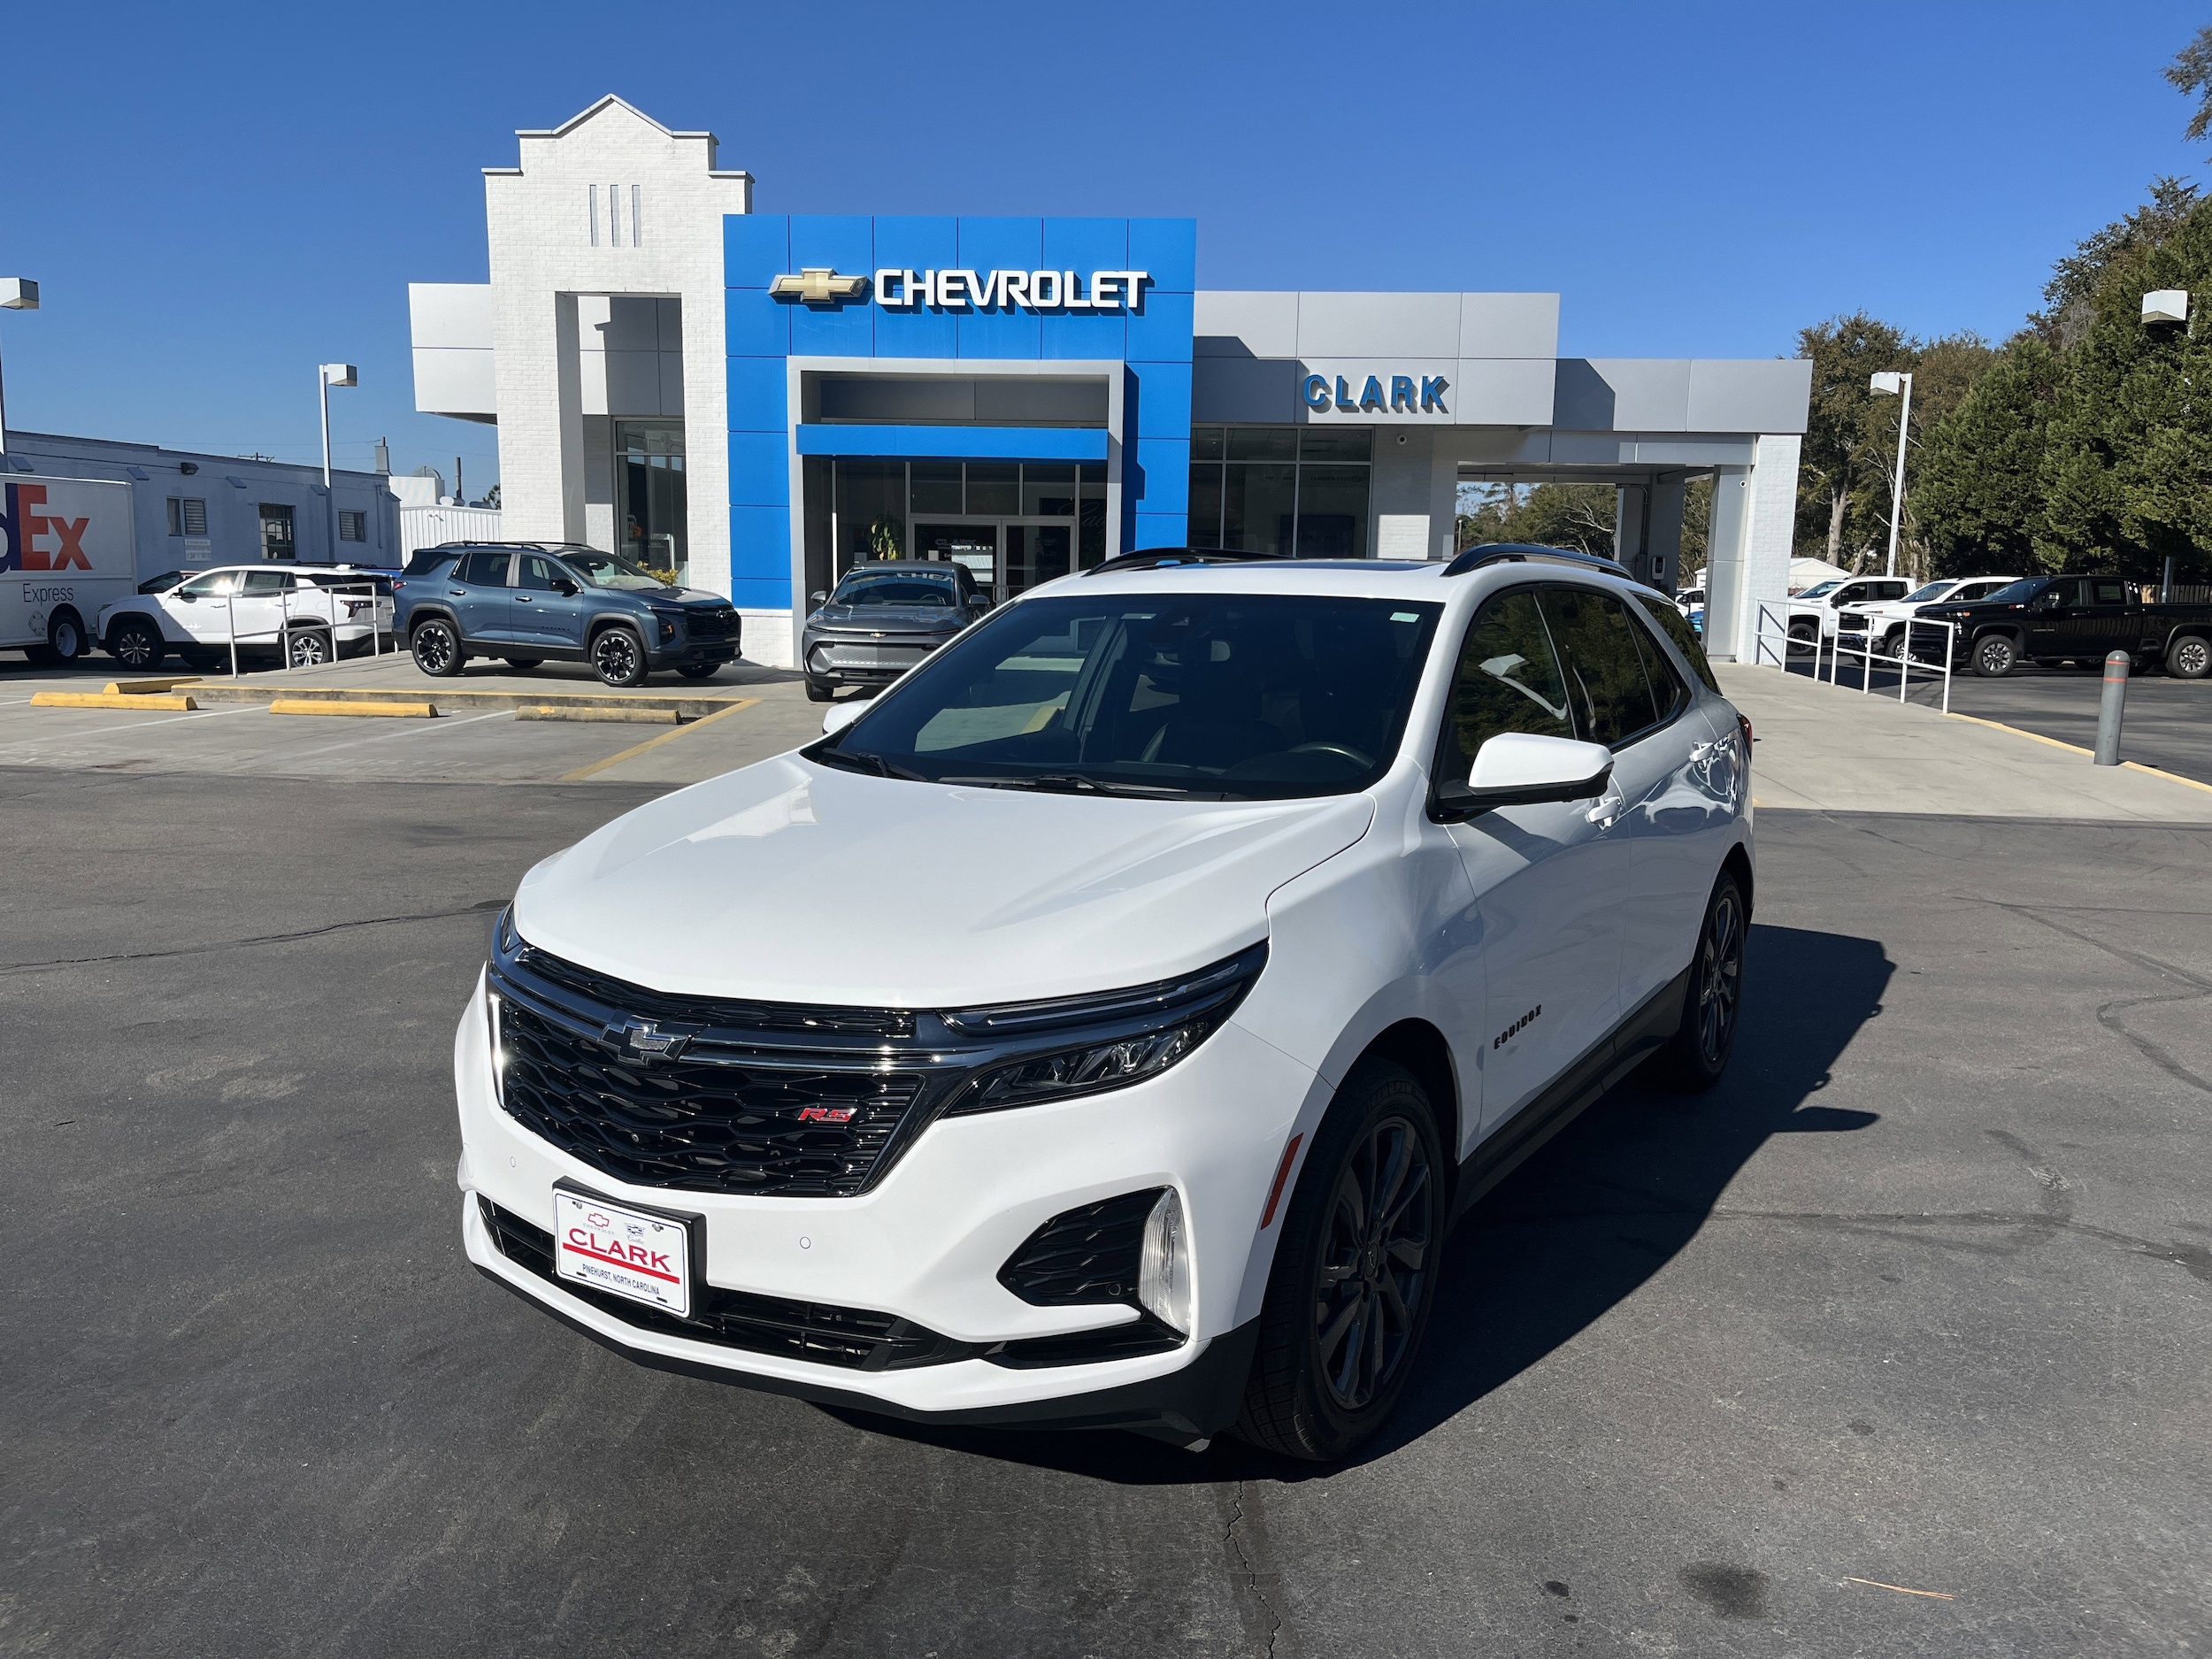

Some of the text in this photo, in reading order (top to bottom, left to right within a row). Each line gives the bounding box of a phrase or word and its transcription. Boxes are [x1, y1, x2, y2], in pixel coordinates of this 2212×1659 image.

[874, 268, 1148, 309] CHEVROLET
[1302, 373, 1445, 407] CLARK
[22, 583, 74, 606] Express
[1494, 1003, 1542, 1050] EQUINOX
[797, 1107, 856, 1123] RS
[582, 1222, 615, 1235] CHEVROLET
[569, 1227, 672, 1272] CLARK
[582, 1263, 660, 1296] PINEHURST, NORTH CAROLINA
